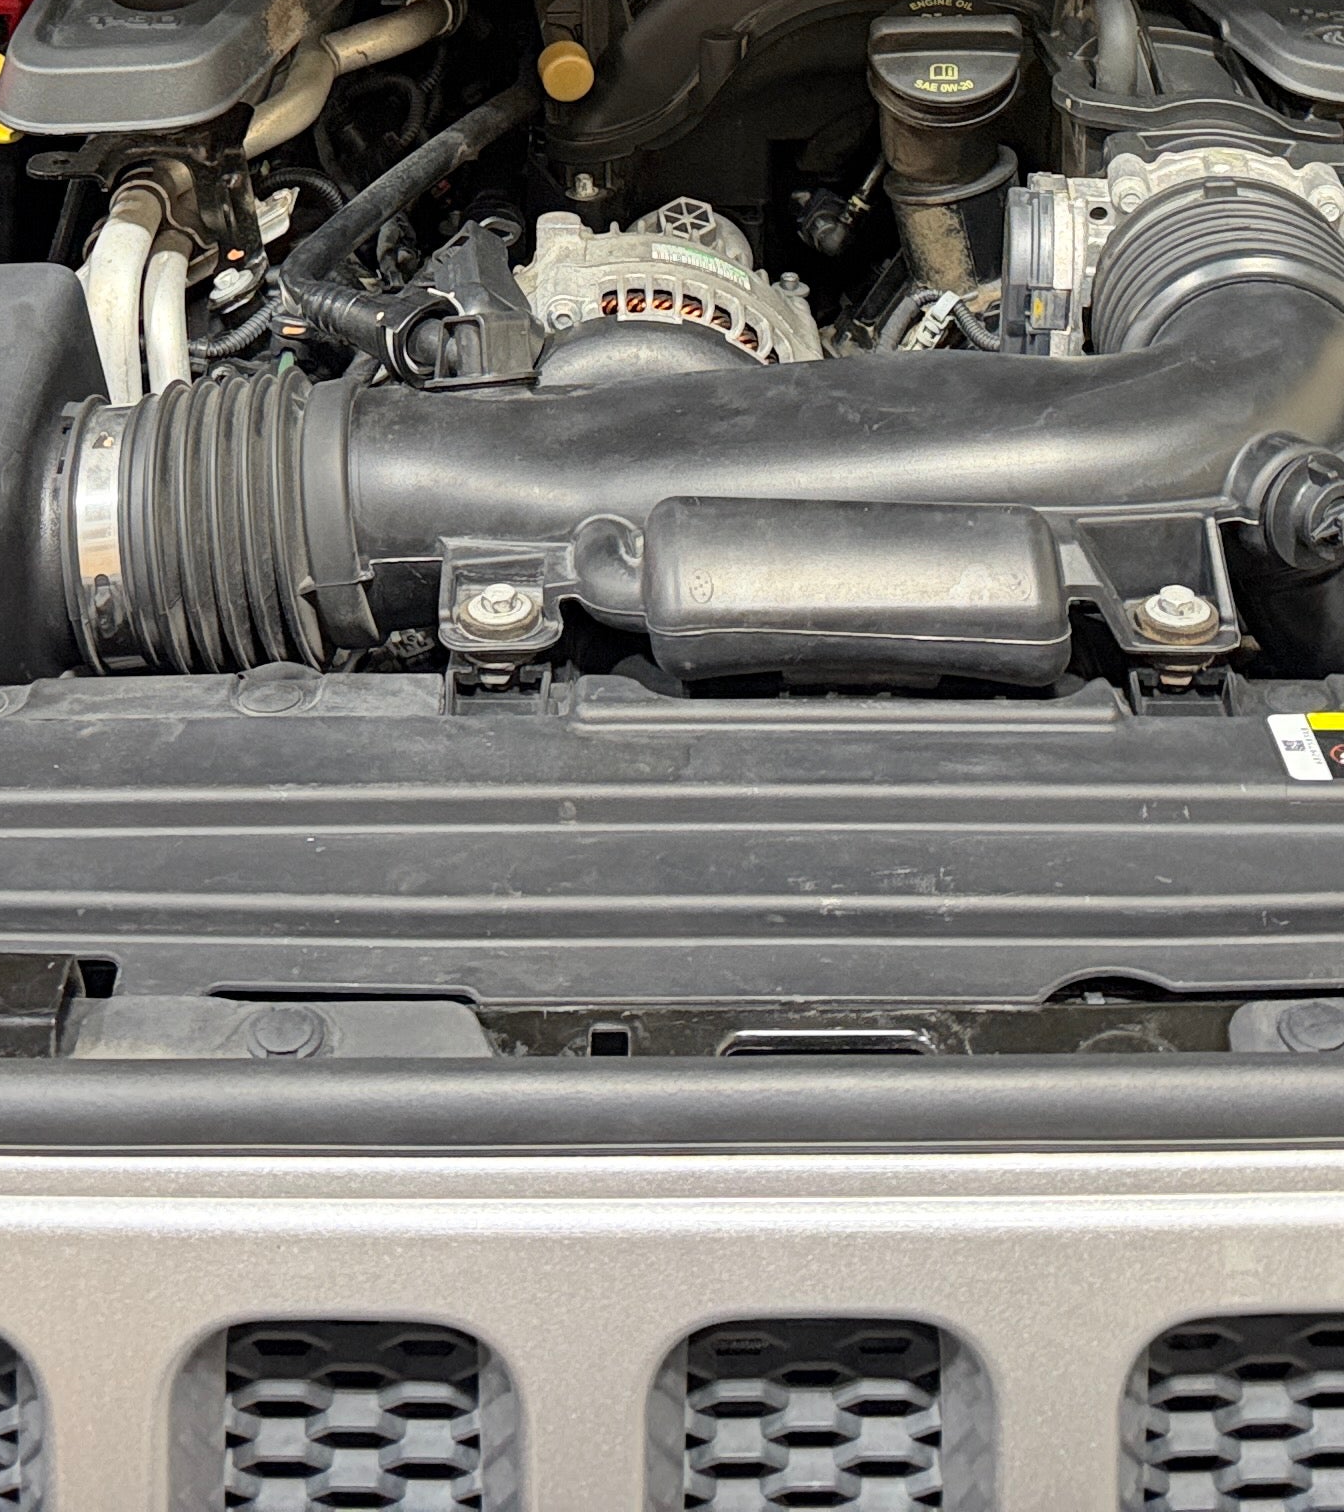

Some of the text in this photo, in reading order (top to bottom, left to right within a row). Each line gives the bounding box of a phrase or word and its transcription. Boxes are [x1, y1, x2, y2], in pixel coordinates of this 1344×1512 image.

[955, 0, 975, 12] OIL
[914, 79, 974, 93] SAE 0W-20
